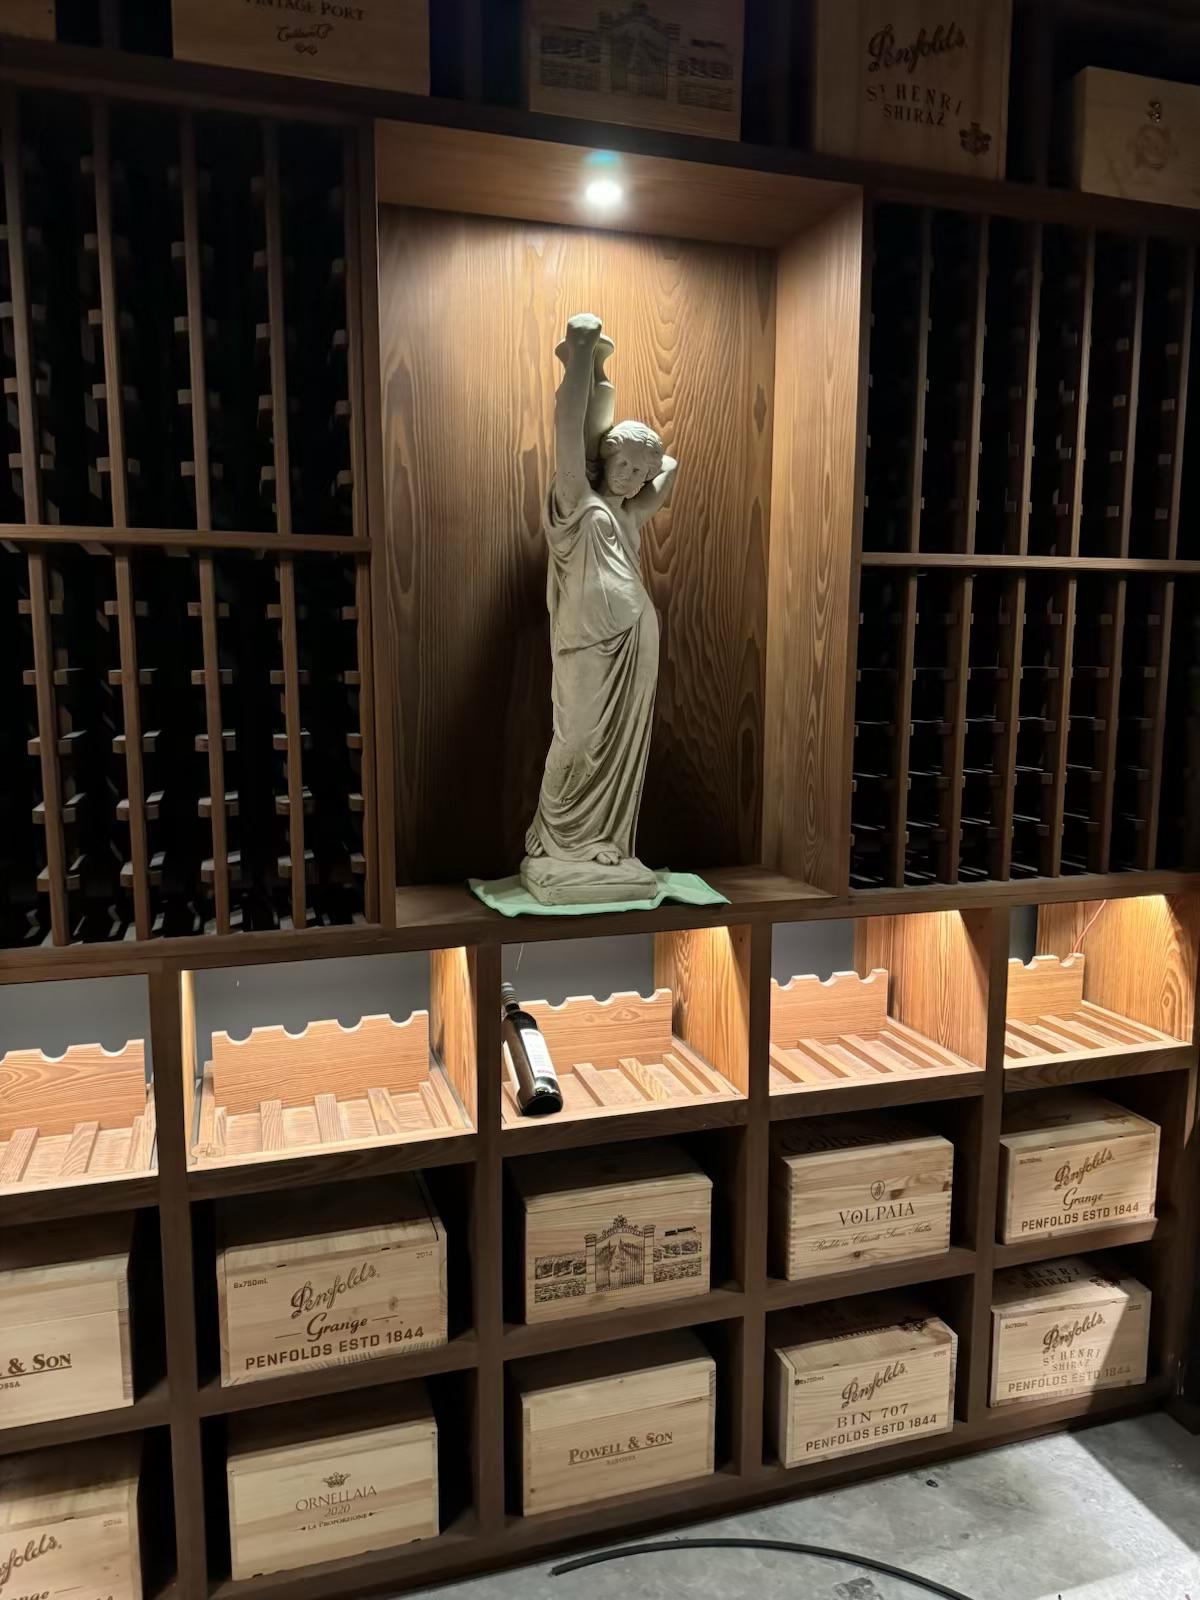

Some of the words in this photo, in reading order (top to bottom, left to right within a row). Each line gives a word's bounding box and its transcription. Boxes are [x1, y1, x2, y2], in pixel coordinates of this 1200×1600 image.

[321, 1, 365, 21] PORT
[896, 83, 963, 117] HENRI
[883, 103, 945, 126] SHIRAZ
[1062, 1187, 1104, 1211] Grange
[839, 1202, 915, 1226] VOLPAIA
[1021, 1212, 1079, 1232] PENFOLDS
[1083, 1205, 1110, 1221] ESTD
[1114, 1202, 1139, 1216] 1844
[306, 1312, 368, 1342] Grange
[246, 1342, 333, 1370] PENFOLDS
[339, 1334, 380, 1353] ESTD
[386, 1326, 424, 1344] 1844
[1060, 1348, 1101, 1361] HENRI
[8, 1357, 27, 1375] &
[1008, 1375, 1068, 1393] PENFOLDS
[1071, 1369, 1101, 1382] ESTD
[837, 1410, 872, 1428] BIN
[881, 1403, 908, 1420] 707
[627, 1436, 640, 1450] &
[805, 1428, 870, 1452] PENFOLDS
[874, 1421, 905, 1440] ESTD
[910, 1414, 937, 1430] 1844
[295, 1485, 378, 1512] ORNELLAIA
[324, 1503, 351, 1518] 2020
